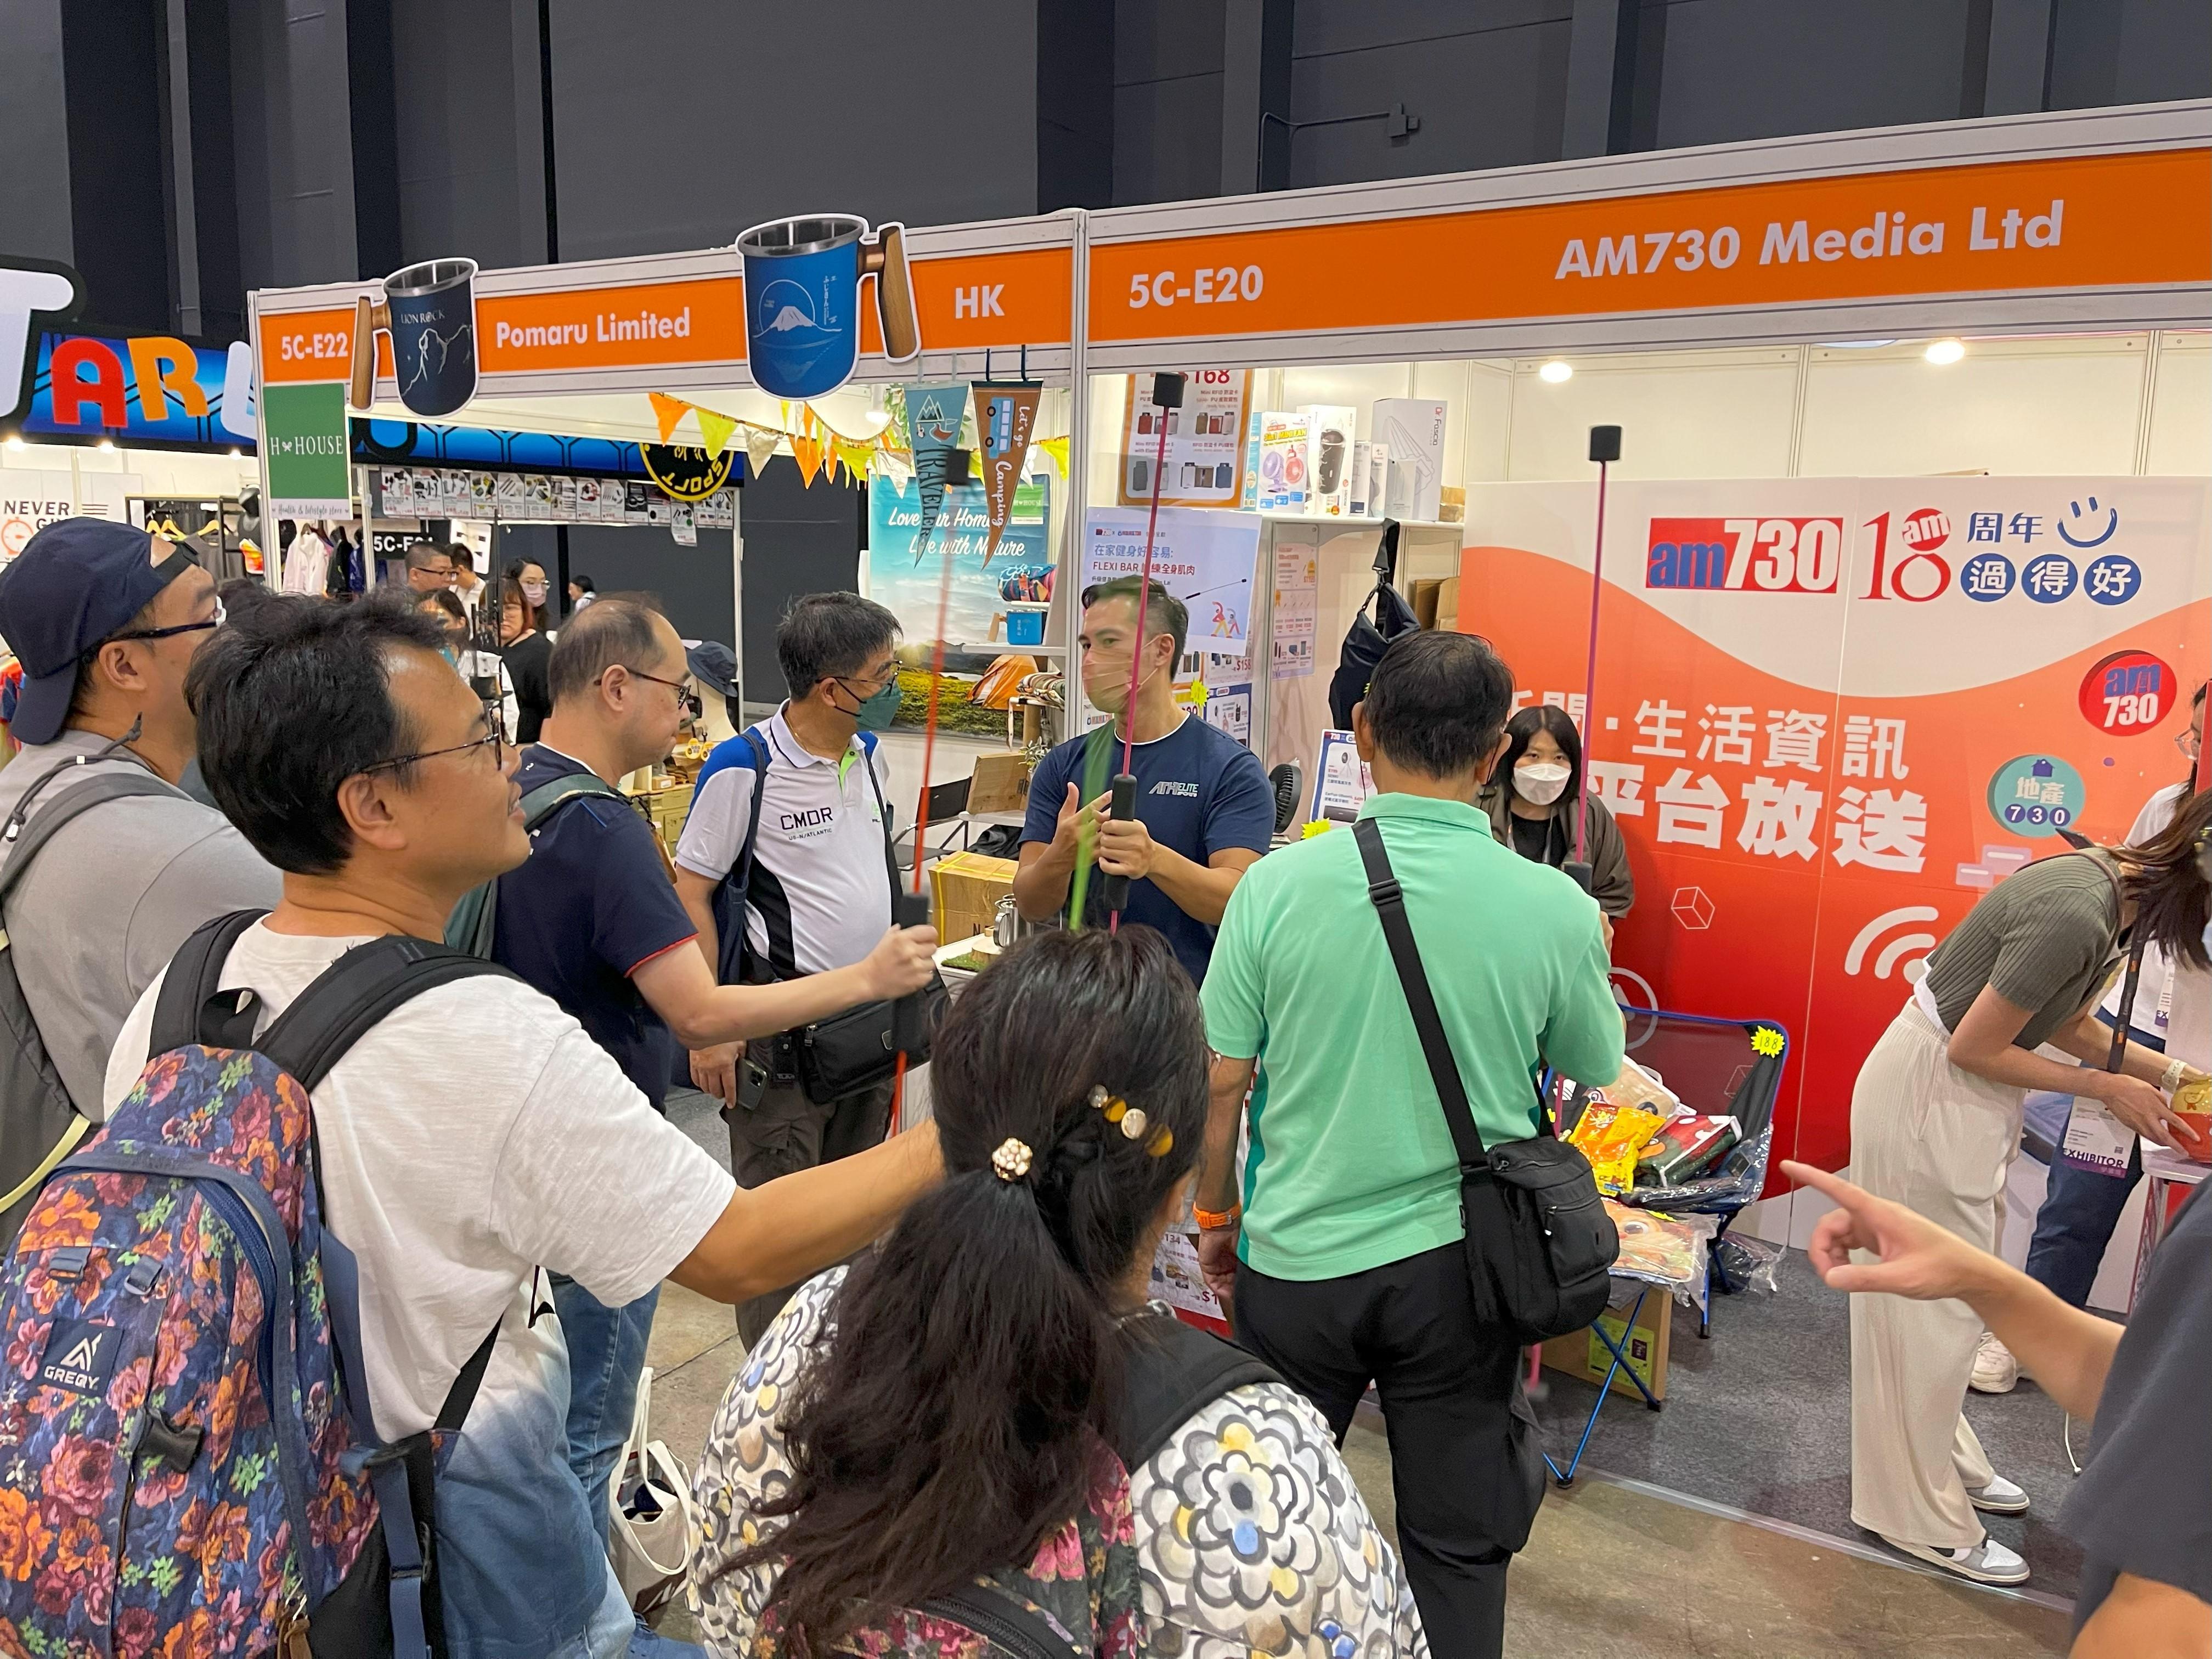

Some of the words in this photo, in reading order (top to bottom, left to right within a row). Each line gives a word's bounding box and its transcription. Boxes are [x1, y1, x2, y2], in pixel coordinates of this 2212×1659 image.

[1554, 226, 1740, 279] AM730
[1759, 211, 1944, 265] Media
[1970, 200, 2064, 251] Ltd
[955, 284, 1005, 319] HK
[1129, 266, 1263, 308] 5C-E20
[496, 321, 588, 348] Pomaru
[597, 307, 690, 343] Limited
[281, 333, 348, 360] 5C-E22
[294, 435, 343, 455] HOUSE
[4, 500, 70, 515] NEVER
[992, 460, 1013, 528] Camping
[888, 506, 920, 526] Love
[935, 512, 951, 527] ur
[953, 507, 990, 527] Hom
[1967, 511, 2044, 544] 周年
[909, 534, 936, 554] Le
[939, 534, 970, 556] with
[974, 535, 1026, 556] Nture
[1647, 519, 1842, 590] am730
[1093, 561, 1118, 571] FLEXI
[1120, 562, 1138, 571] BAR
[1968, 560, 2133, 596] 過得好
[2103, 662, 2162, 696] am
[2102, 693, 2160, 729] 730
[1632, 699, 1909, 781] 生活資訊
[2015, 777, 2065, 805] 地產
[780, 807, 833, 830] CMDR
[1587, 759, 1928, 874] 平台放送
[2011, 806, 2066, 825] 730
[1759, 1036, 1779, 1050] 188
